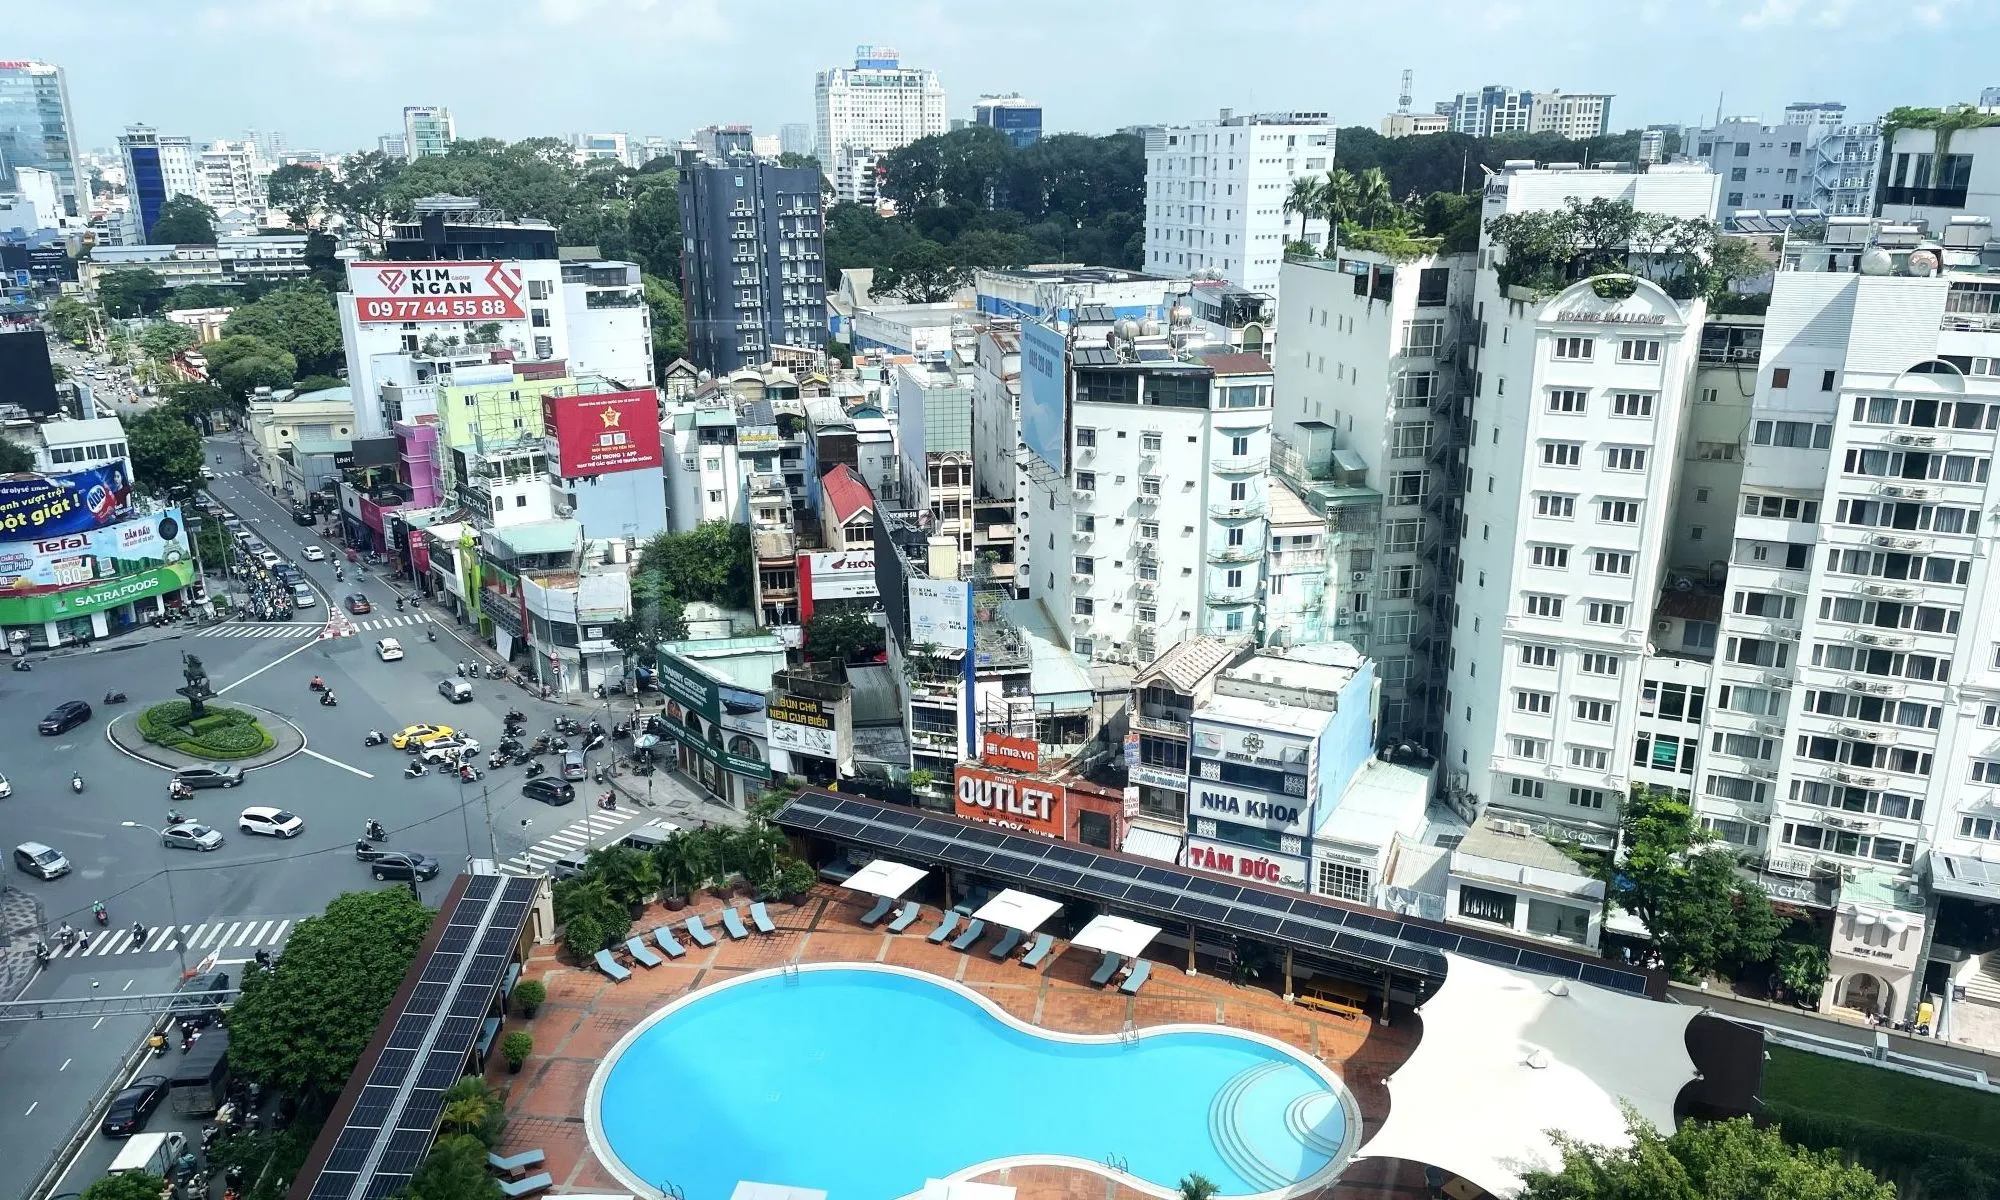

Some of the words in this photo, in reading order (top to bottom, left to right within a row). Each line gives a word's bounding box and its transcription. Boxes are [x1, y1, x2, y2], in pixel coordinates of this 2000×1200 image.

[411, 269, 449, 281] KIM
[412, 282, 472, 294] NGAN
[368, 302, 393, 316] 09
[396, 302, 421, 316] 77
[424, 301, 448, 315] 44
[453, 301, 477, 315] 55
[481, 300, 506, 314] 88
[21, 494, 46, 504] vượt
[47, 487, 65, 498] trội
[31, 498, 70, 526] giặt
[33, 534, 92, 553] Tefal
[55, 568, 81, 585] 180
[789, 712, 807, 724] CUA
[1000, 746, 1035, 761] mia.vn
[1226, 751, 1252, 762] DENTAL
[958, 775, 1053, 820] OUTLET
[1201, 791, 1240, 814] NHA
[1245, 799, 1299, 826] KHOA
[1191, 847, 1233, 873] TÂM
[1239, 856, 1280, 883] ĐỨC
[1778, 885, 1810, 900] CITY
